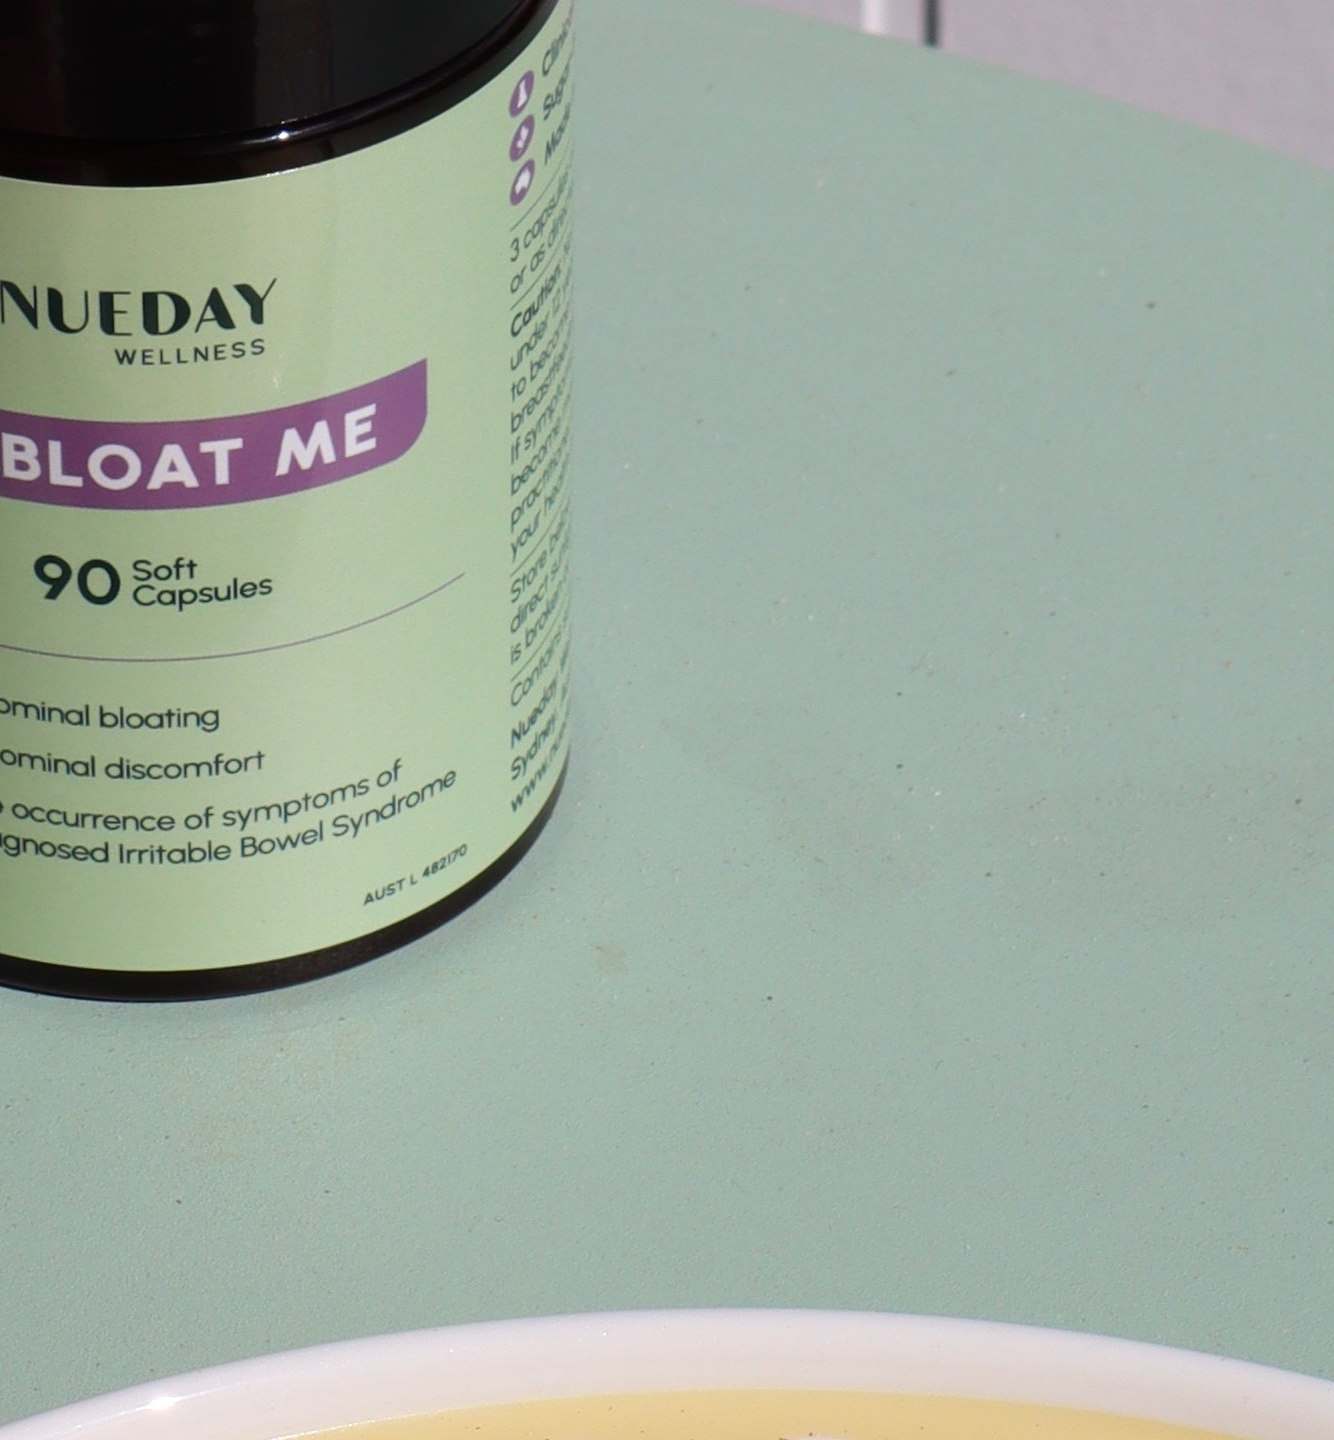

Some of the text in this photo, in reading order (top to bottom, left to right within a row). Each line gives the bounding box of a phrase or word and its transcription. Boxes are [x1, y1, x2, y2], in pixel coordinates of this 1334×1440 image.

[510, 237, 520, 262] 3
[510, 265, 527, 294] or
[530, 243, 546, 271] as
[0, 277, 278, 336] NUEDAY
[114, 338, 266, 365] WELLNESS
[510, 311, 550, 371] under
[510, 376, 527, 402] to
[275, 403, 377, 476] ME
[511, 510, 541, 563] your
[33, 554, 121, 605] 90
[132, 558, 198, 581] Soft
[132, 576, 273, 611] Capsules
[511, 550, 547, 604] Store
[511, 574, 548, 633] direct
[511, 642, 522, 666] is
[99, 704, 220, 733] bloating
[105, 750, 265, 780] discomfort
[11, 800, 175, 832] occurrence
[184, 806, 214, 831] of
[222, 778, 370, 831] symptoms
[376, 757, 402, 788] of
[119, 840, 231, 864] Irritable
[240, 820, 324, 859] Bowel
[332, 770, 457, 838] Syndrome
[363, 878, 406, 906] AUST
[410, 874, 418, 886] L
